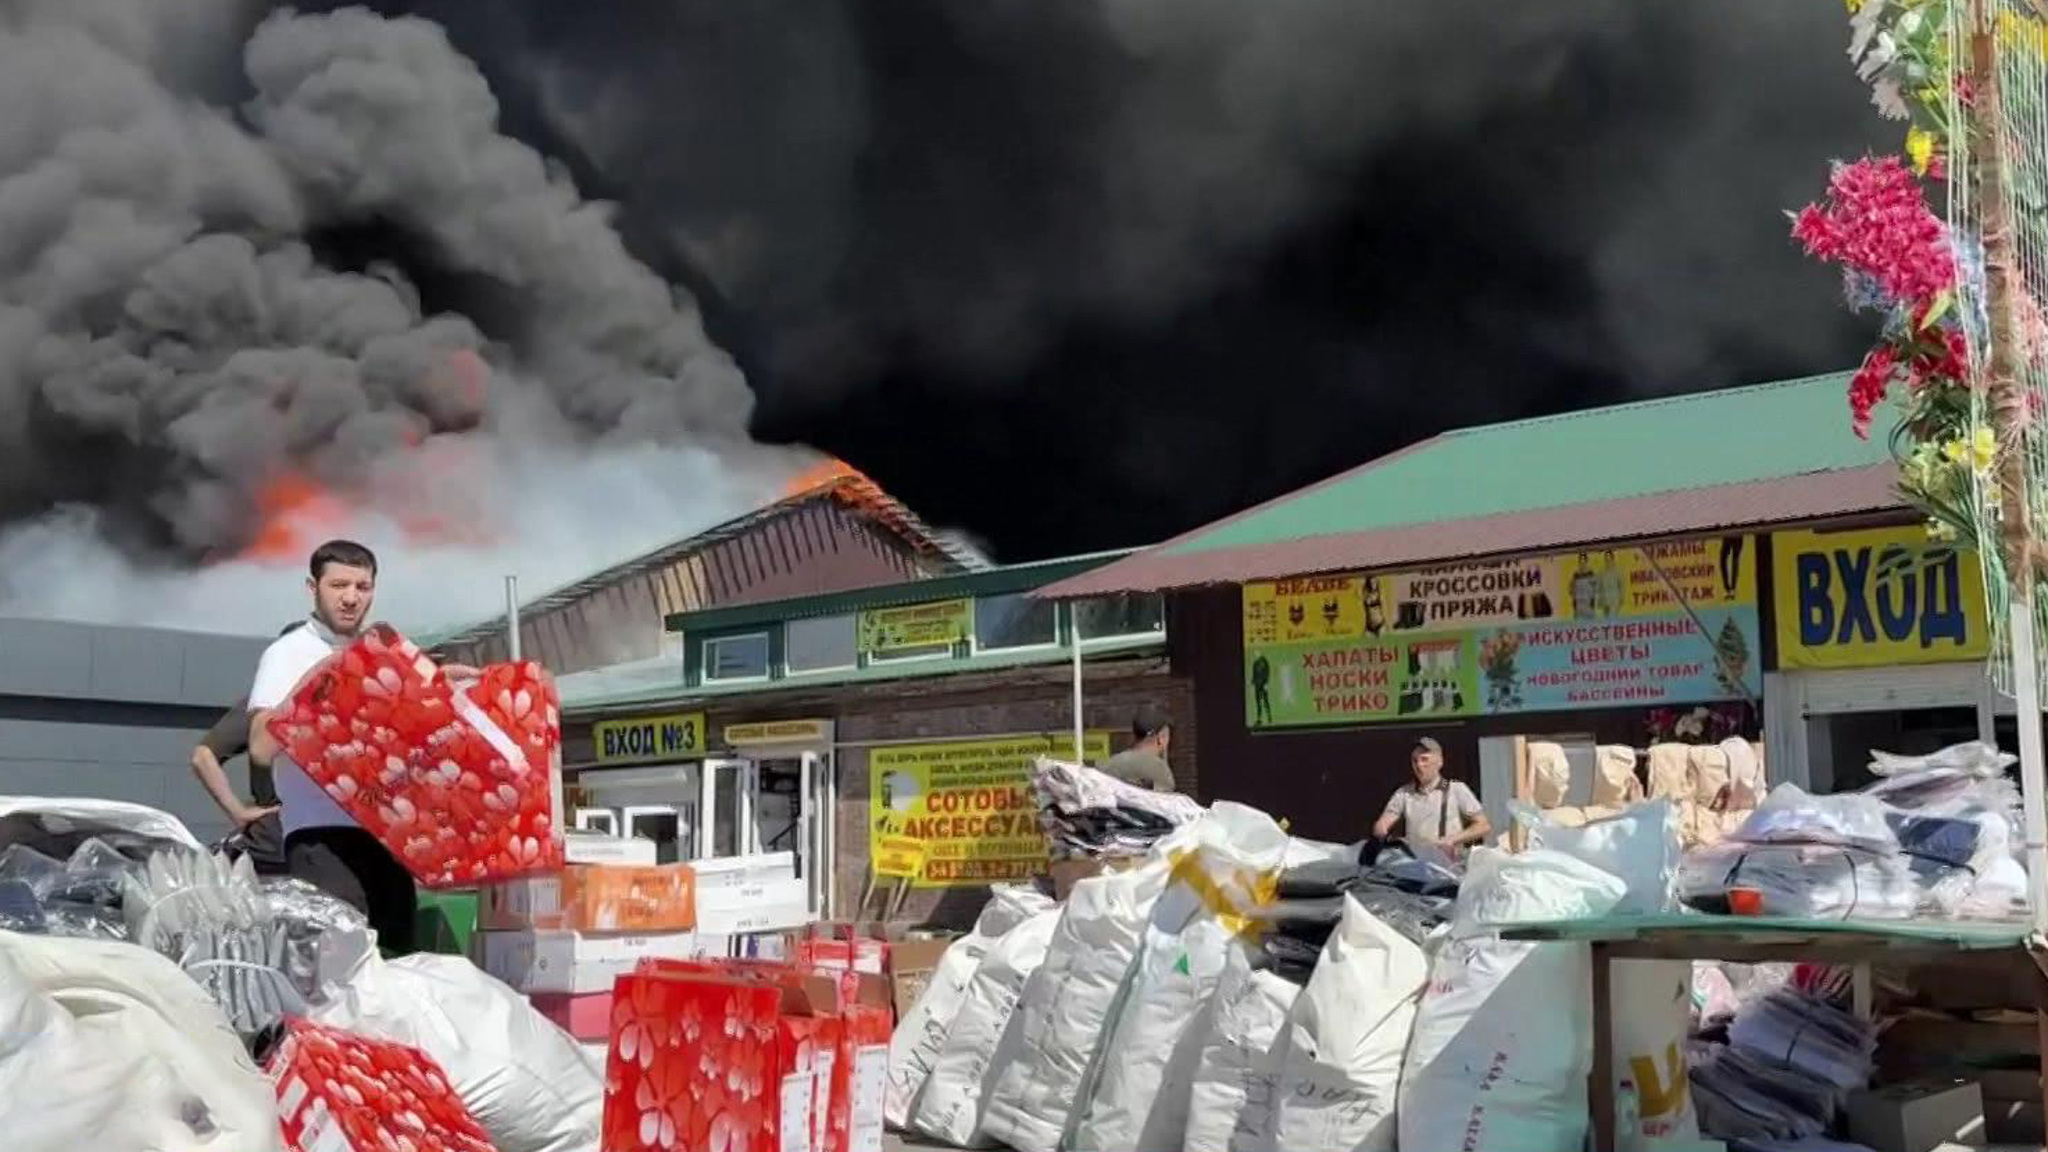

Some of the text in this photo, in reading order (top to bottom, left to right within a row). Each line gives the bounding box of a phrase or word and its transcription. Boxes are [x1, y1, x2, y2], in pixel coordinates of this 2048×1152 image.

[1410, 563, 1542, 598] КРОССОВКИ
[1431, 594, 1514, 620] ПРЯЖА
[1797, 545, 1965, 648] ВХОД
[1529, 619, 1698, 647] ИСКУССТВЕННЫЕ
[1571, 643, 1650, 665] ЦВЕТЫ
[1311, 670, 1389, 691] НОСКИ
[1313, 693, 1389, 713] ТРИКО
[603, 726, 656, 757] ВХОД
[662, 721, 695, 750] №3
